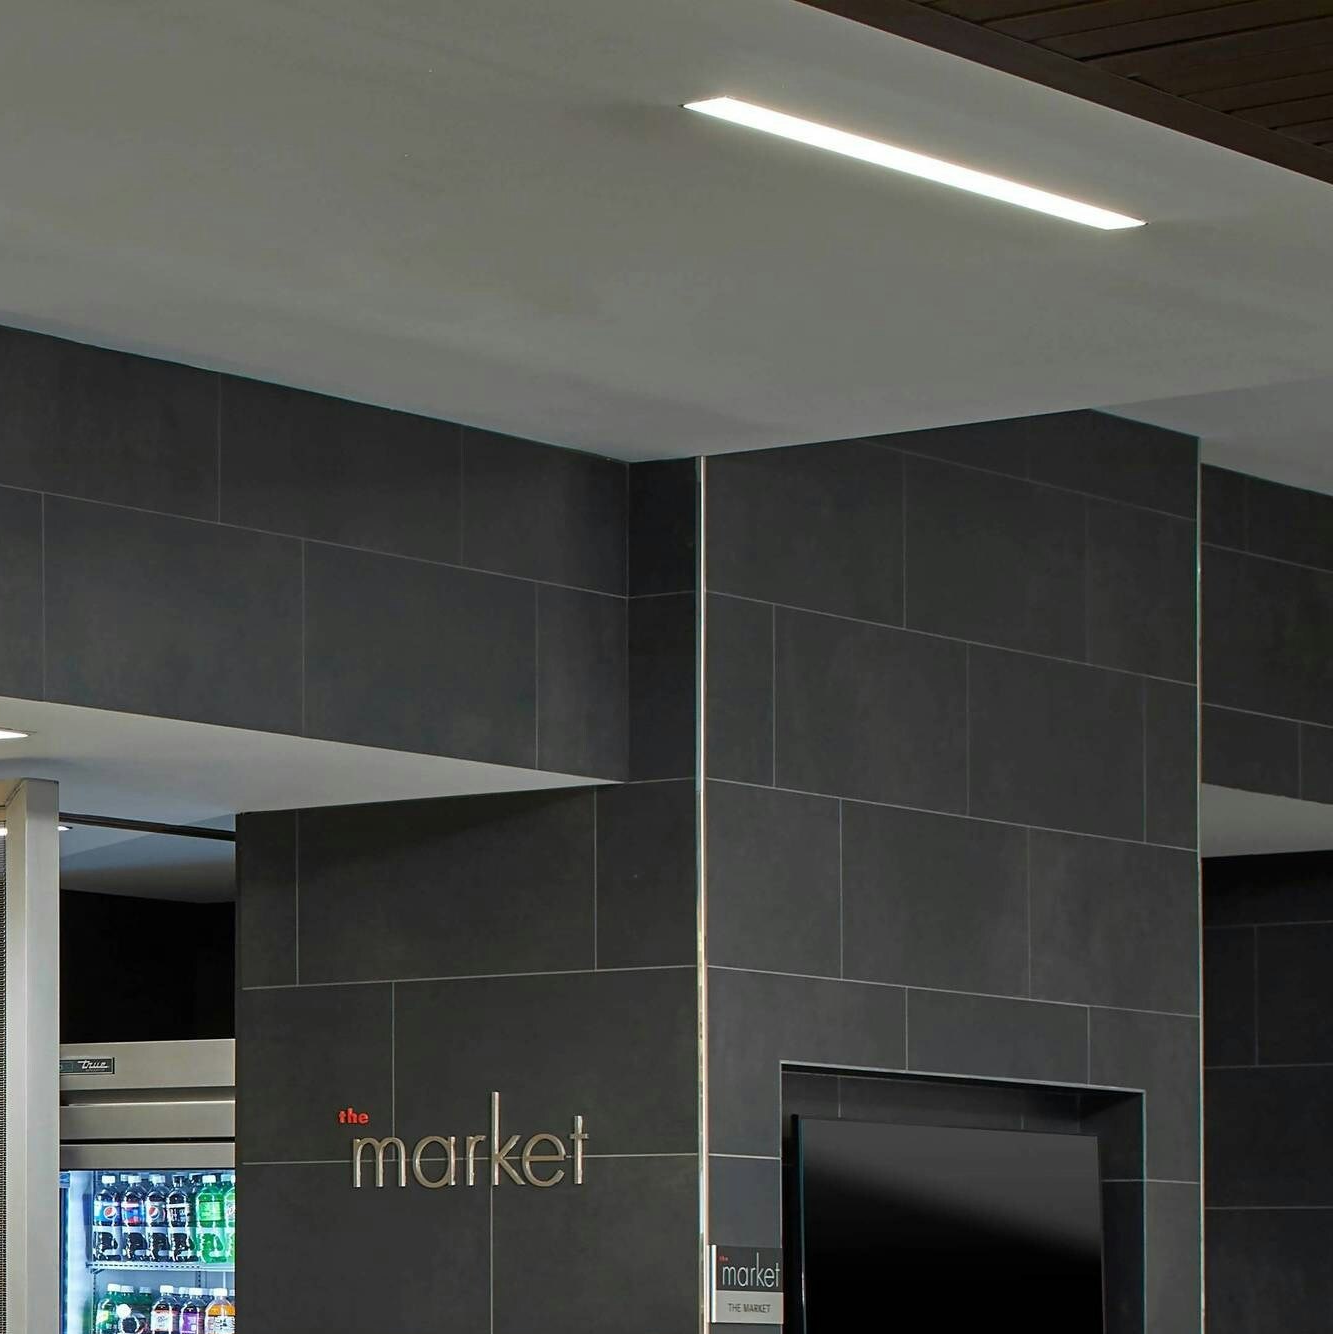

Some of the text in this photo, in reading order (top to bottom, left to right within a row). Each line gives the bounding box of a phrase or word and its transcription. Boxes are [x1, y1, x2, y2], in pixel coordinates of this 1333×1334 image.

[338, 1108, 370, 1124] the
[352, 1091, 589, 1188] market
[722, 1252, 780, 1288] market
[727, 1303, 771, 1313] THE MARKET
